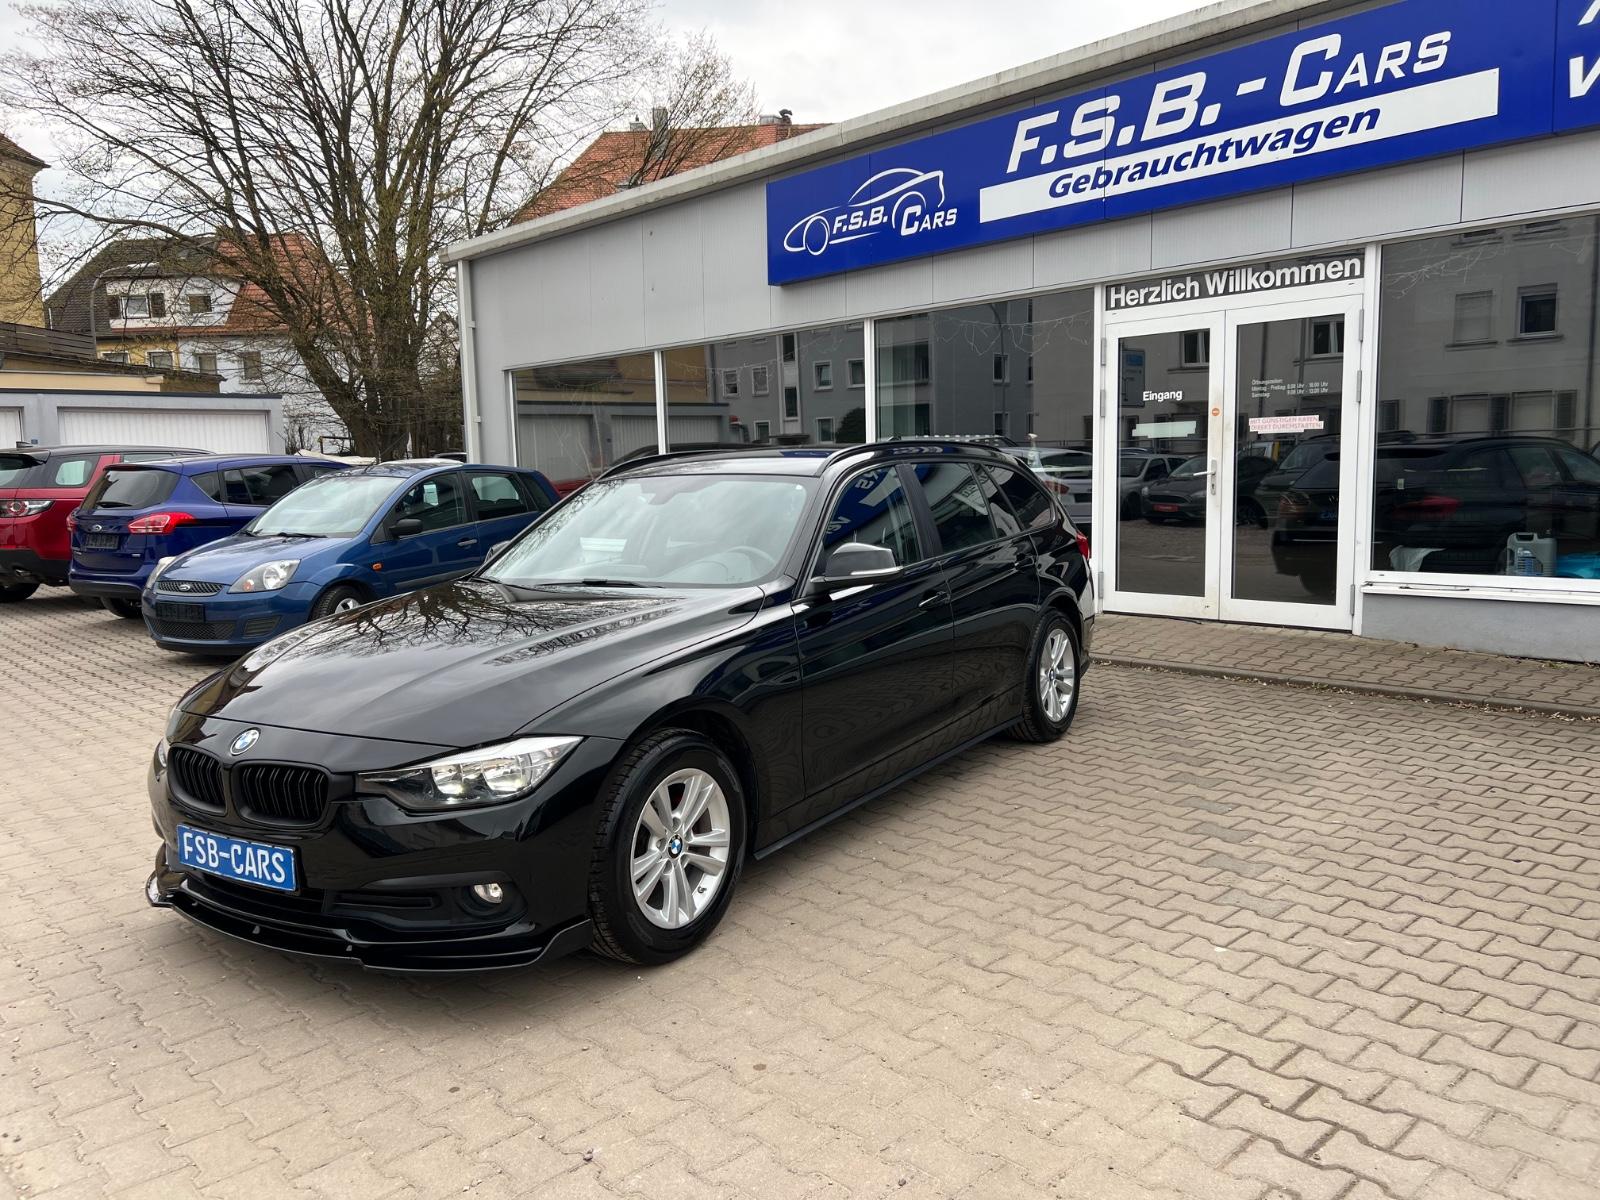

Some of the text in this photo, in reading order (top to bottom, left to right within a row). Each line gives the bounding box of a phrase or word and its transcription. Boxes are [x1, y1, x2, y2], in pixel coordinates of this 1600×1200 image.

[1048, 106, 1381, 199] Gebrauchtwagen
[833, 204, 958, 236] F.S.B. CARS
[1109, 257, 1361, 308] Herzlich Willkommen
[1142, 390, 1183, 402] Eingang
[182, 832, 287, 883] FSB-CARS
